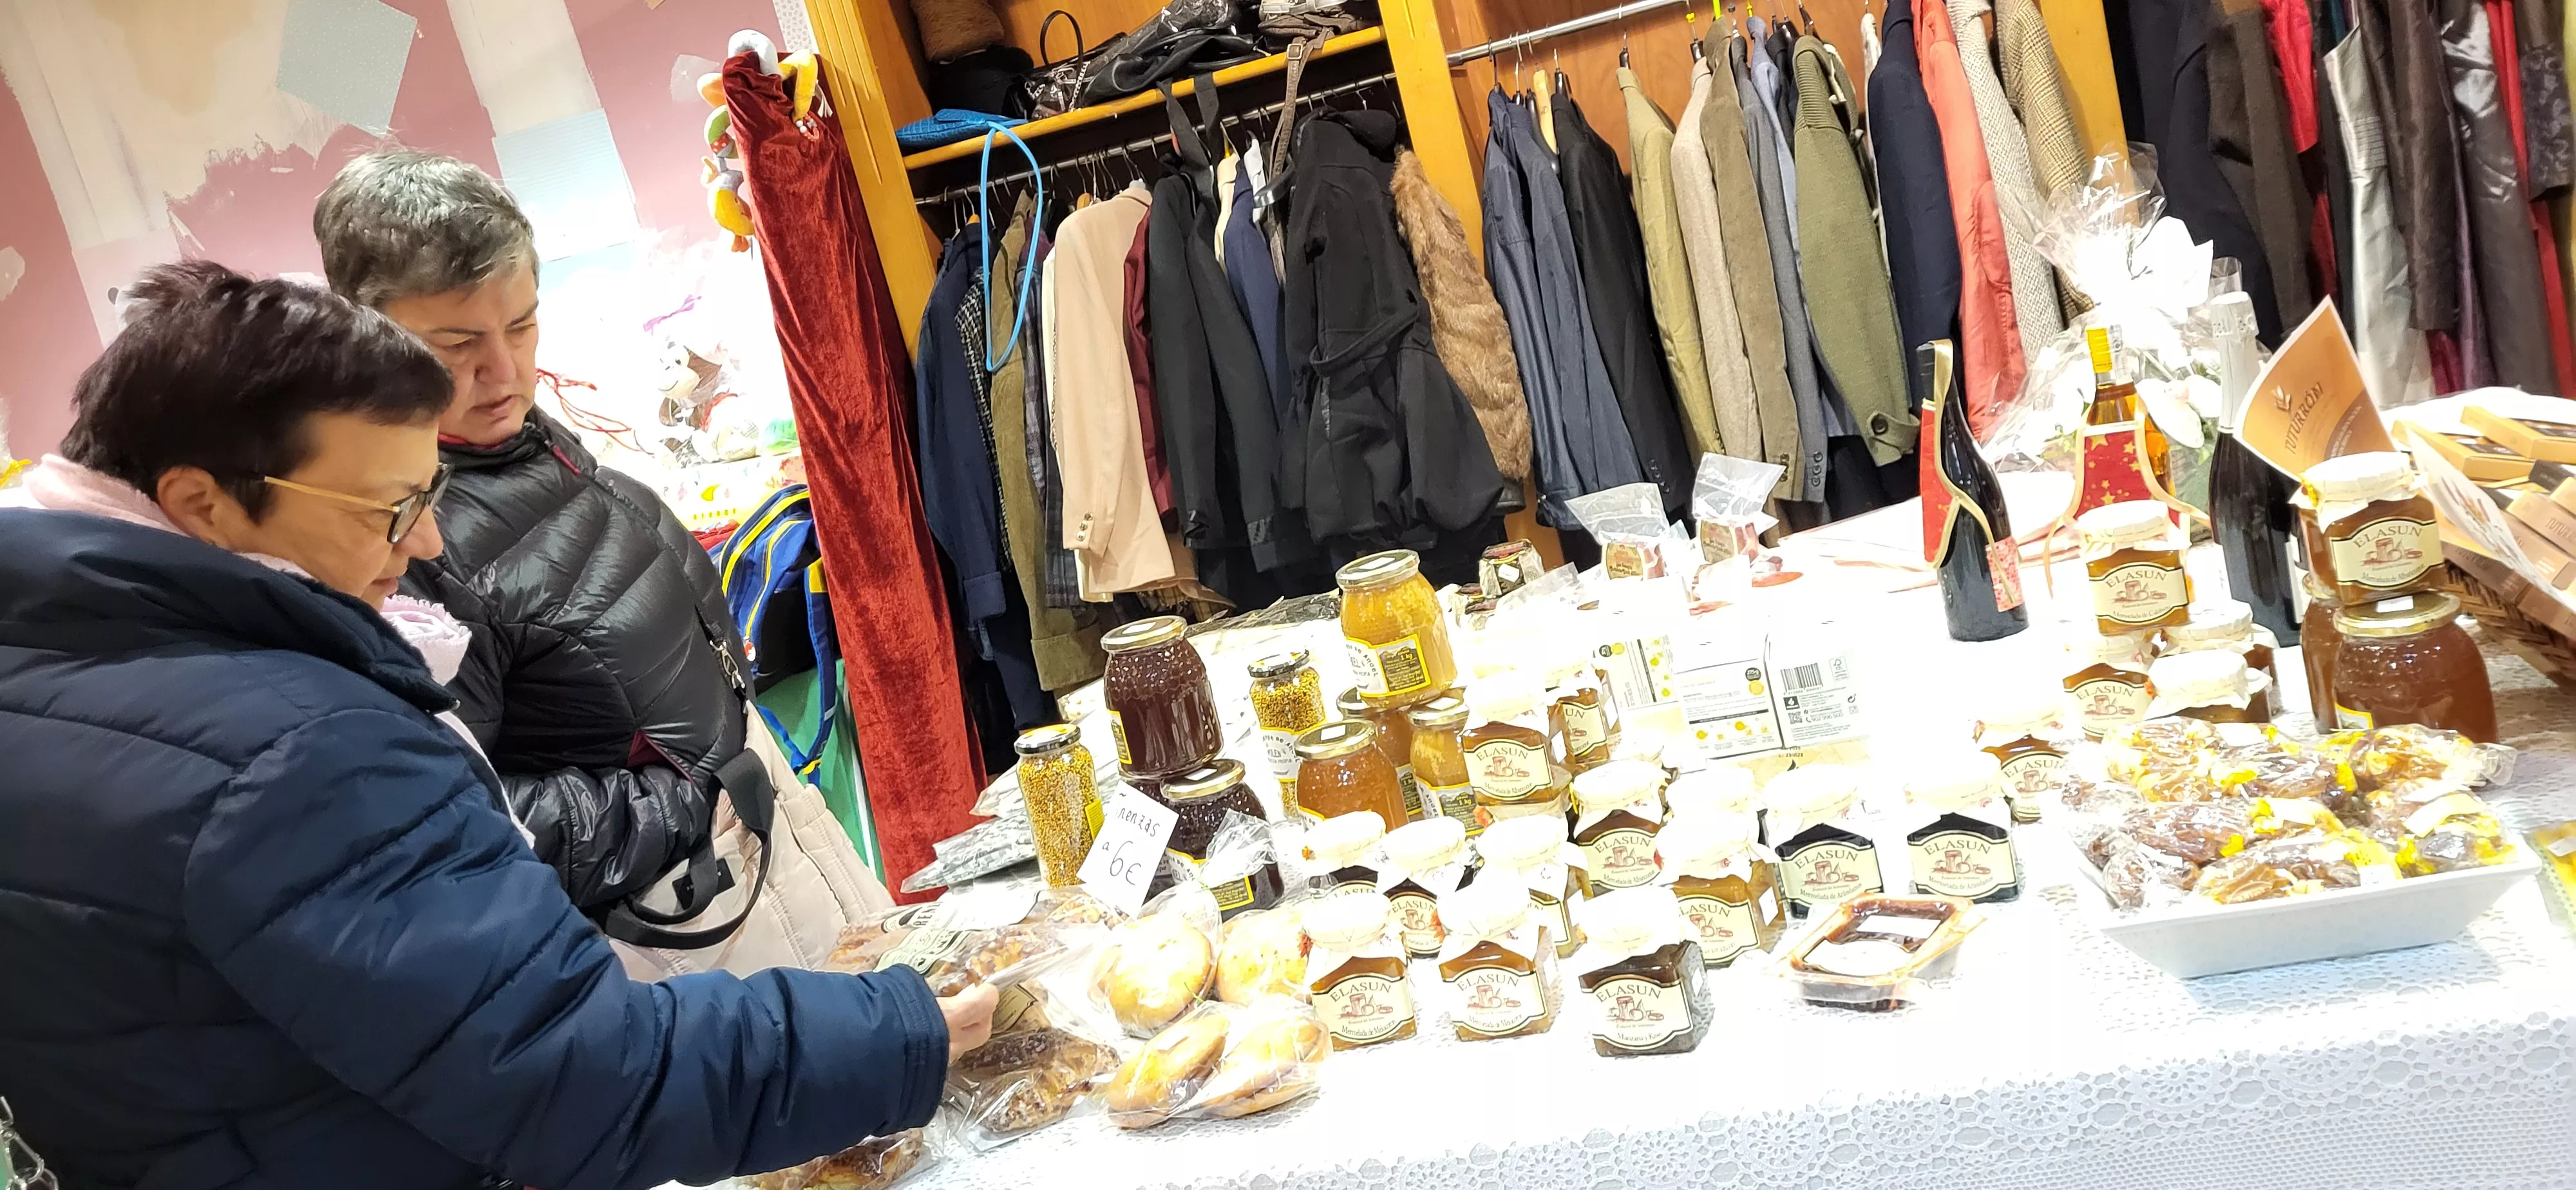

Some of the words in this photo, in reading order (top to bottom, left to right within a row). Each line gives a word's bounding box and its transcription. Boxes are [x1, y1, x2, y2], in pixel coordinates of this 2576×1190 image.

[2353, 525, 2423, 548] ELASUN
[2105, 571, 2166, 588] ELASUN
[2076, 686, 2134, 700] ELASUN
[1476, 747, 1528, 761] ELASUN
[1102, 842, 1110, 851] a
[1595, 836, 1651, 853] ELASUN
[1924, 839, 1991, 856] ELASUN
[1794, 850, 1858, 869] ELASUN
[1678, 903, 1730, 918] LASUN
[1457, 974, 1519, 991] ELASUN
[1330, 982, 1391, 1002] ELASUN
[1596, 985, 1661, 1003] ELASUN
